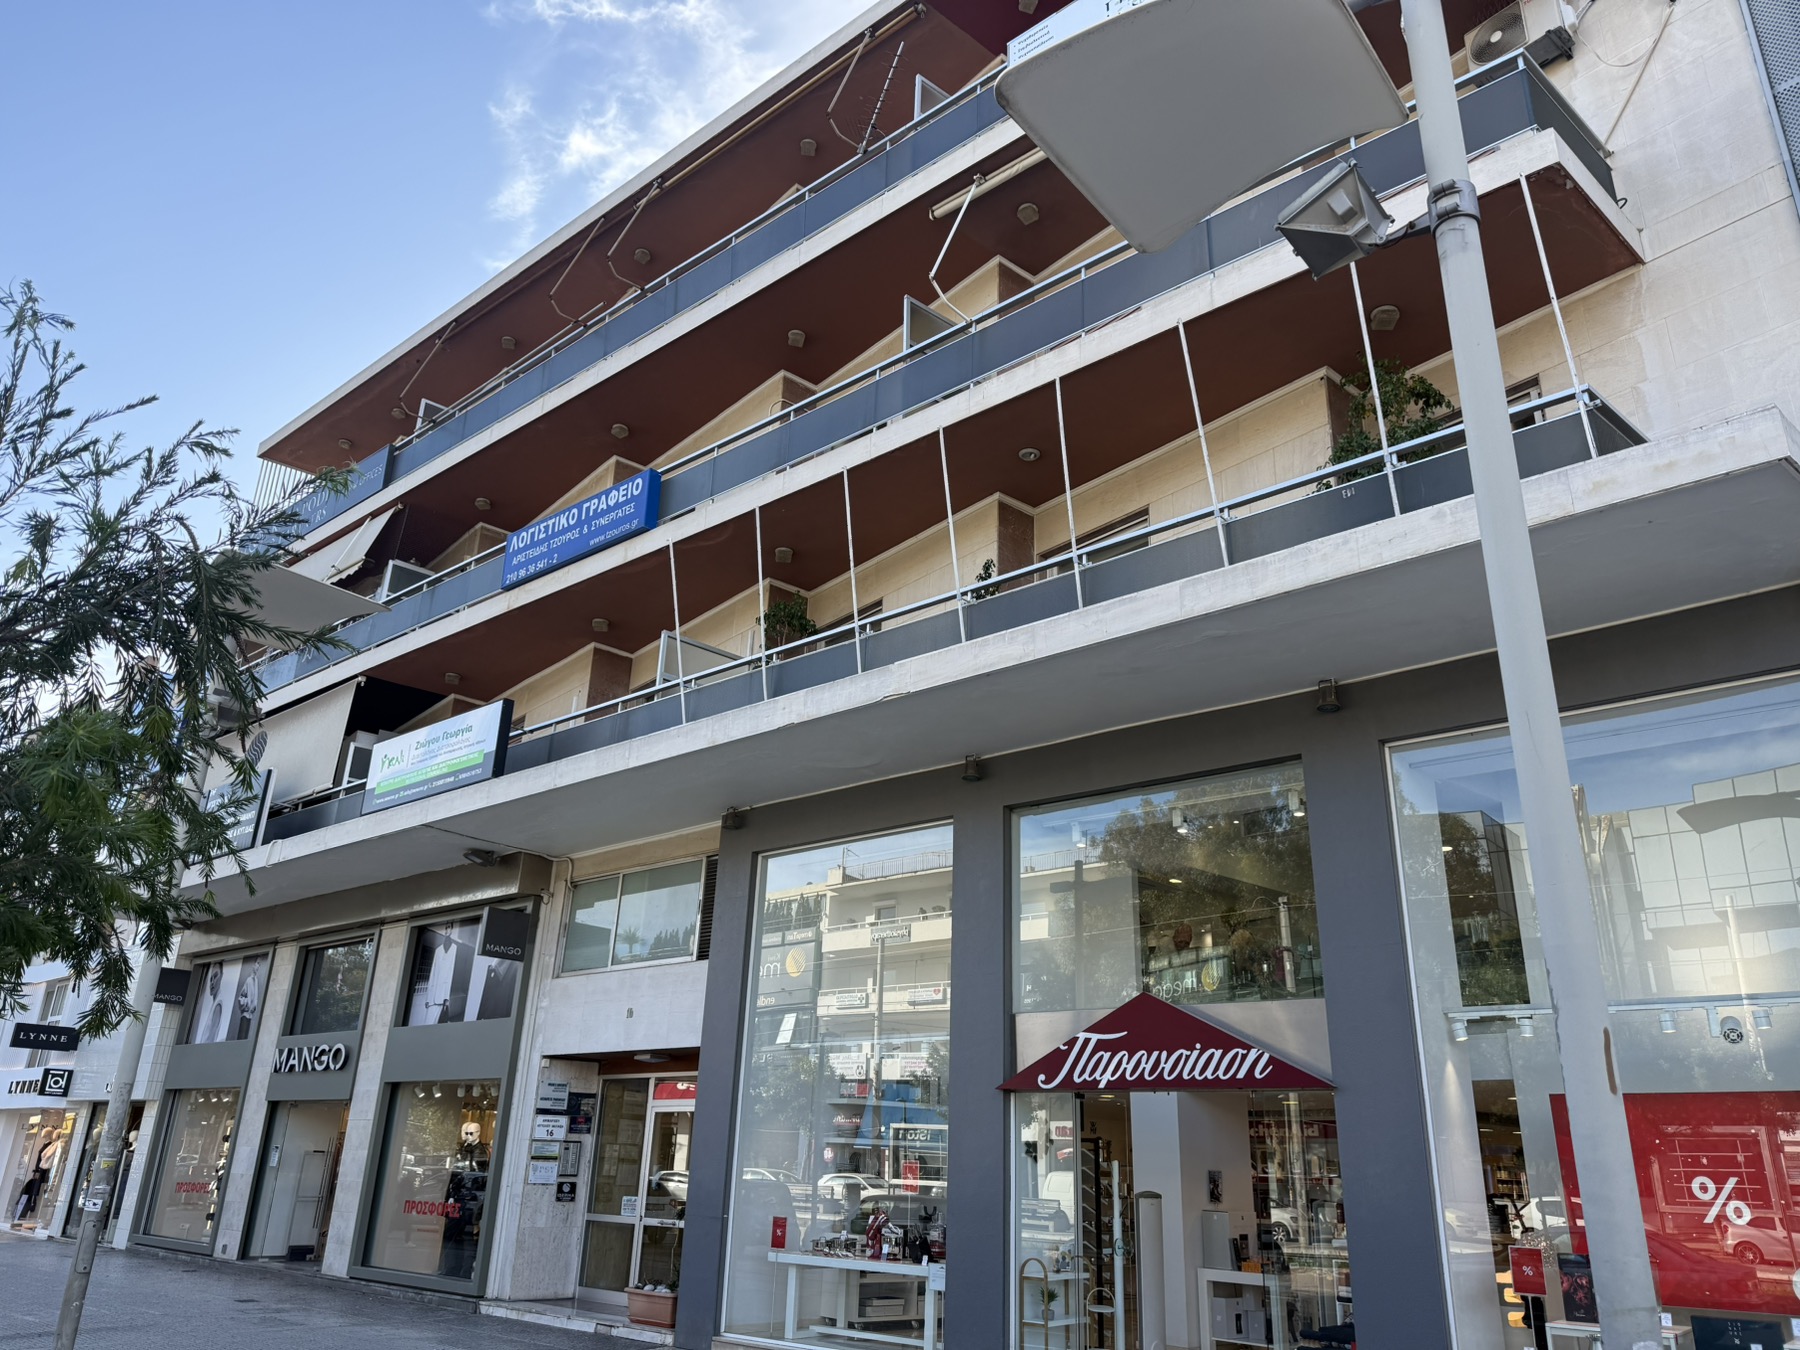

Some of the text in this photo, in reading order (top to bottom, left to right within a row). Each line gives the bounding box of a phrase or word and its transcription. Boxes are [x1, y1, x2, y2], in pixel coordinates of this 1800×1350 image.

[509, 478, 643, 553] ΛΟΓΙΣΤΙΚΟ ΓΡΑΦΕΙΟ
[511, 502, 636, 566] ΑΡΙΣΤΕΙΔΗΣ ΤΖΟΥΡΟΣ & ΣΥΝΕΡΓΑΤΕΣ
[589, 518, 640, 546] www.tzouros.gr
[506, 571, 518, 584] 210
[518, 568, 527, 579] 96
[536, 559, 548, 572] 541
[552, 554, 558, 564] 2
[415, 724, 473, 750] Ζιώγου Γεωργία
[485, 944, 522, 956] MANGO
[19, 1031, 68, 1043] LYNNE
[272, 1043, 346, 1073] MANGO
[8, 1079, 40, 1094] LYNNE
[403, 1199, 462, 1218] ΠΡΟΣΦΟΡΕΣ
[1690, 1176, 1752, 1226] %
[1522, 1265, 1534, 1276] %
